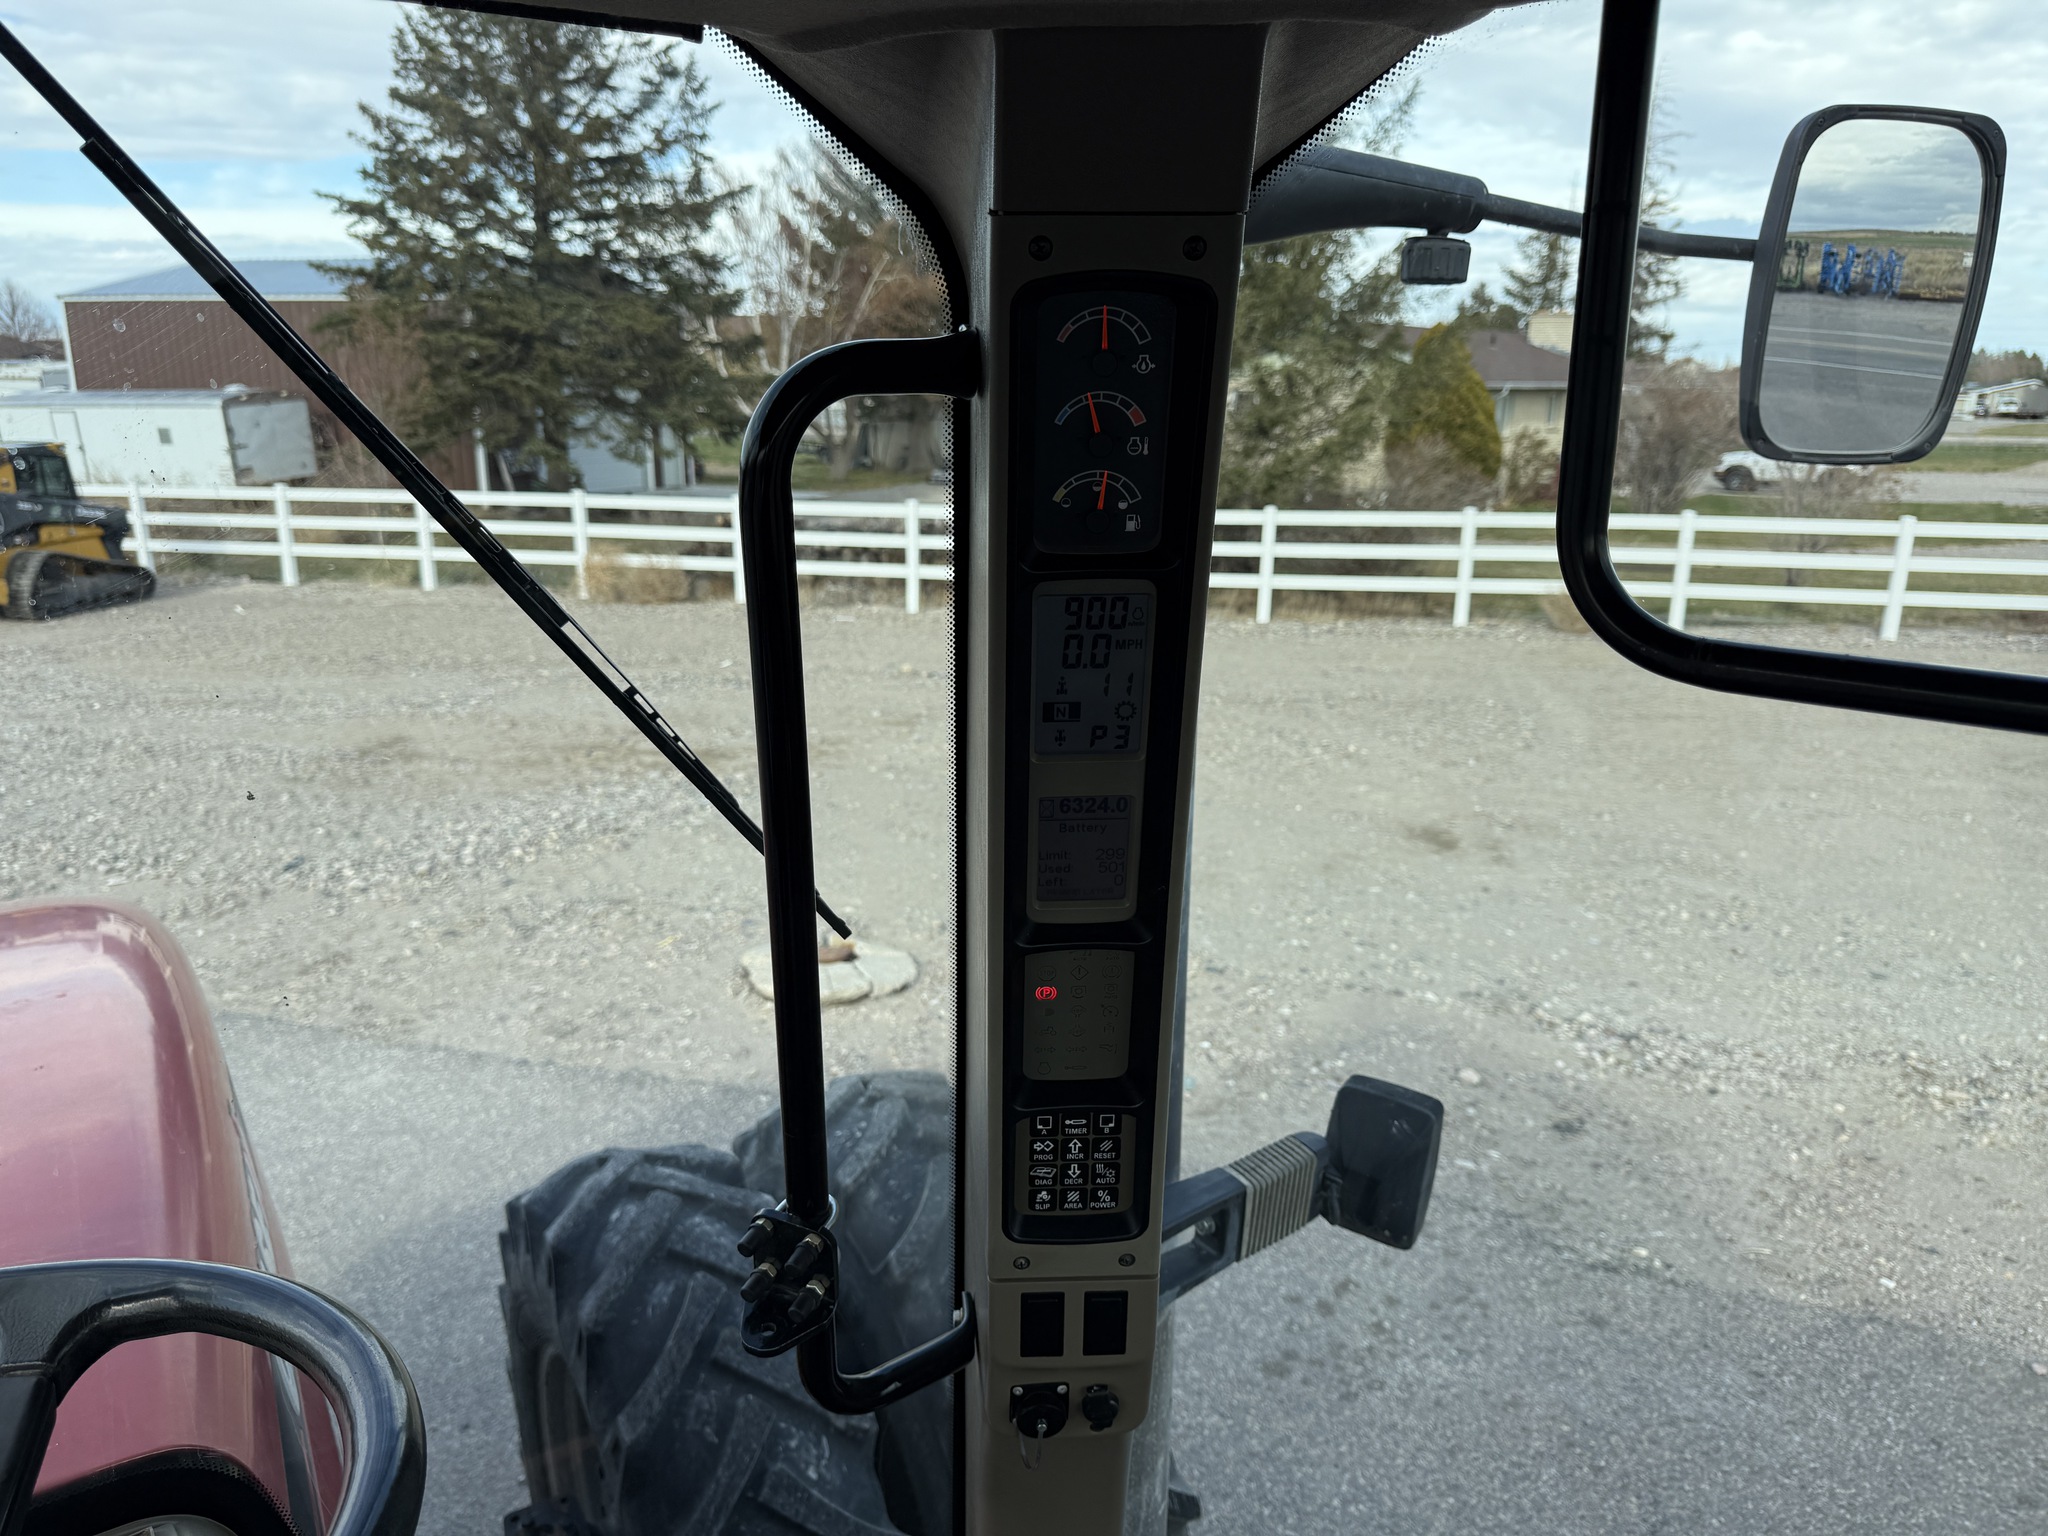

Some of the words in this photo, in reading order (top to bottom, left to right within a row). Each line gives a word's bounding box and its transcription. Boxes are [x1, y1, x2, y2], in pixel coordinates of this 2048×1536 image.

[1064, 596, 1129, 630] 900
[1061, 634, 1113, 669] 0.0
[1115, 639, 1143, 650] MPH
[1055, 706, 1066, 718] N
[1060, 797, 1129, 814] 6324.0
[1059, 823, 1108, 835] Battery
[1113, 874, 1124, 886] 0
